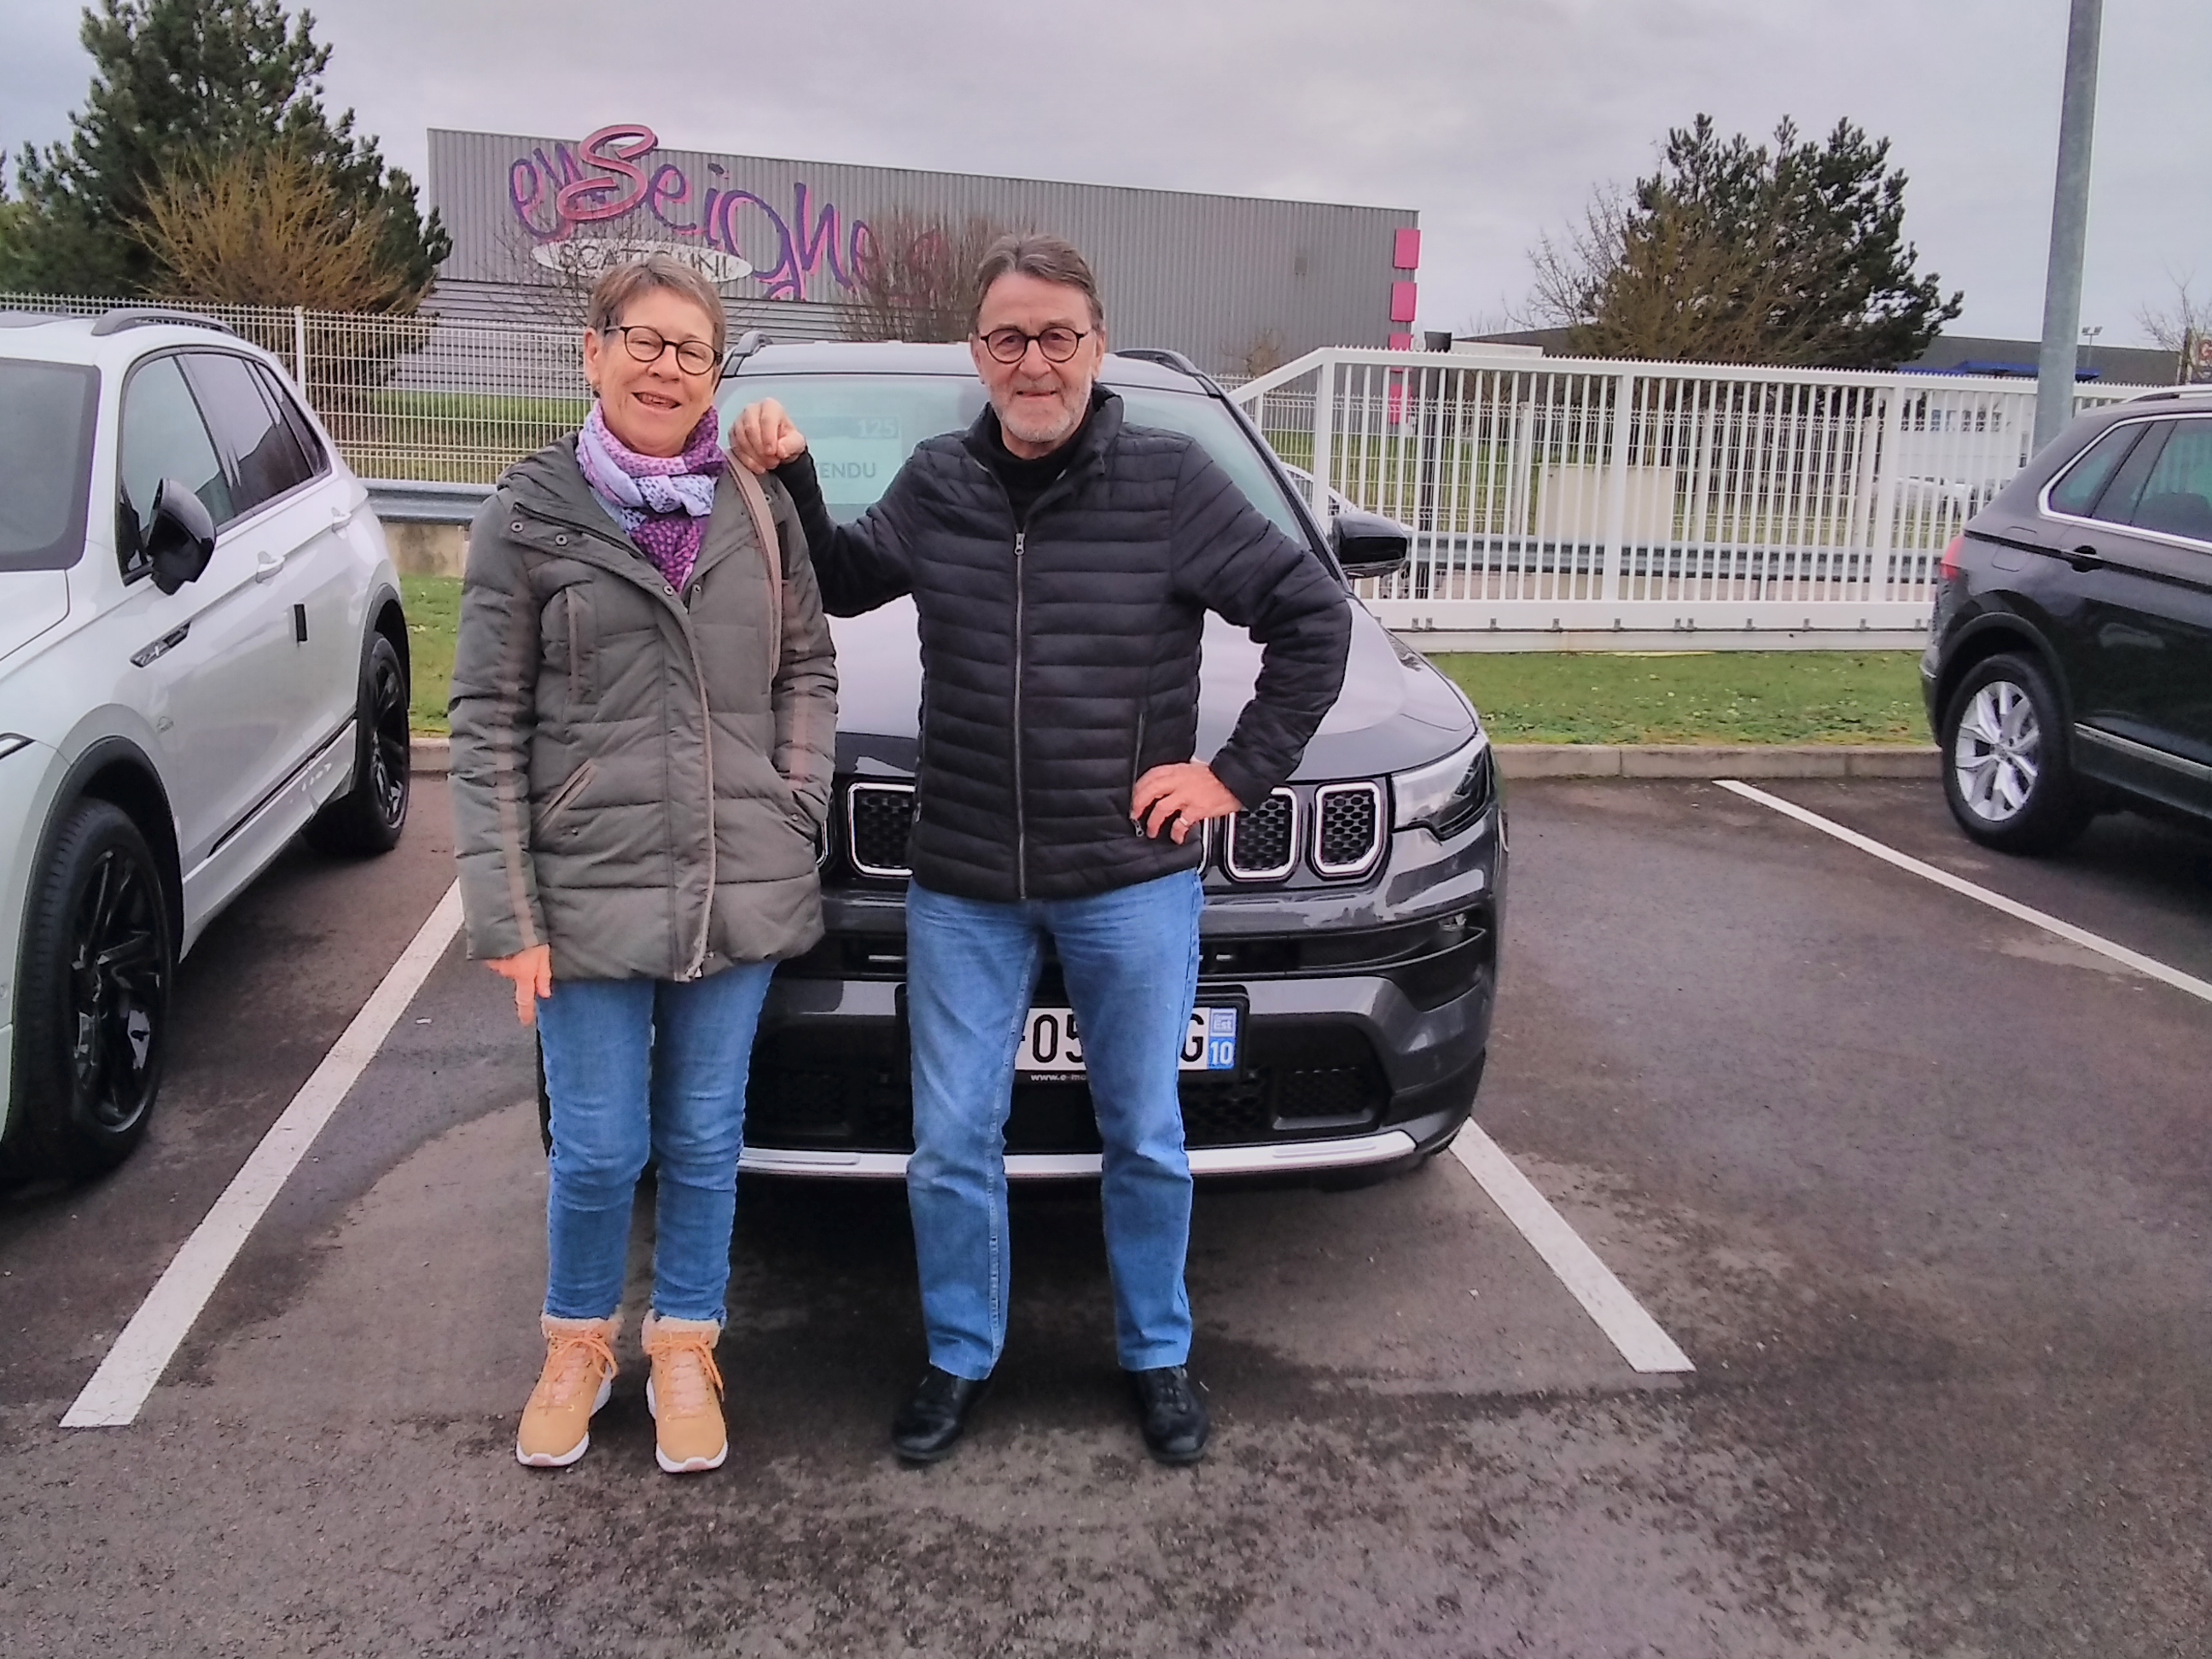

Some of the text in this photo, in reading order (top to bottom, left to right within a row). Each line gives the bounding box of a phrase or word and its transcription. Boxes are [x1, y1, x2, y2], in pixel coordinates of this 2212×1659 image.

[858, 418, 895, 438] 125
[815, 462, 876, 479] ENDU
[1213, 1020, 1232, 1030] Est
[1210, 1040, 1234, 1066] 10
